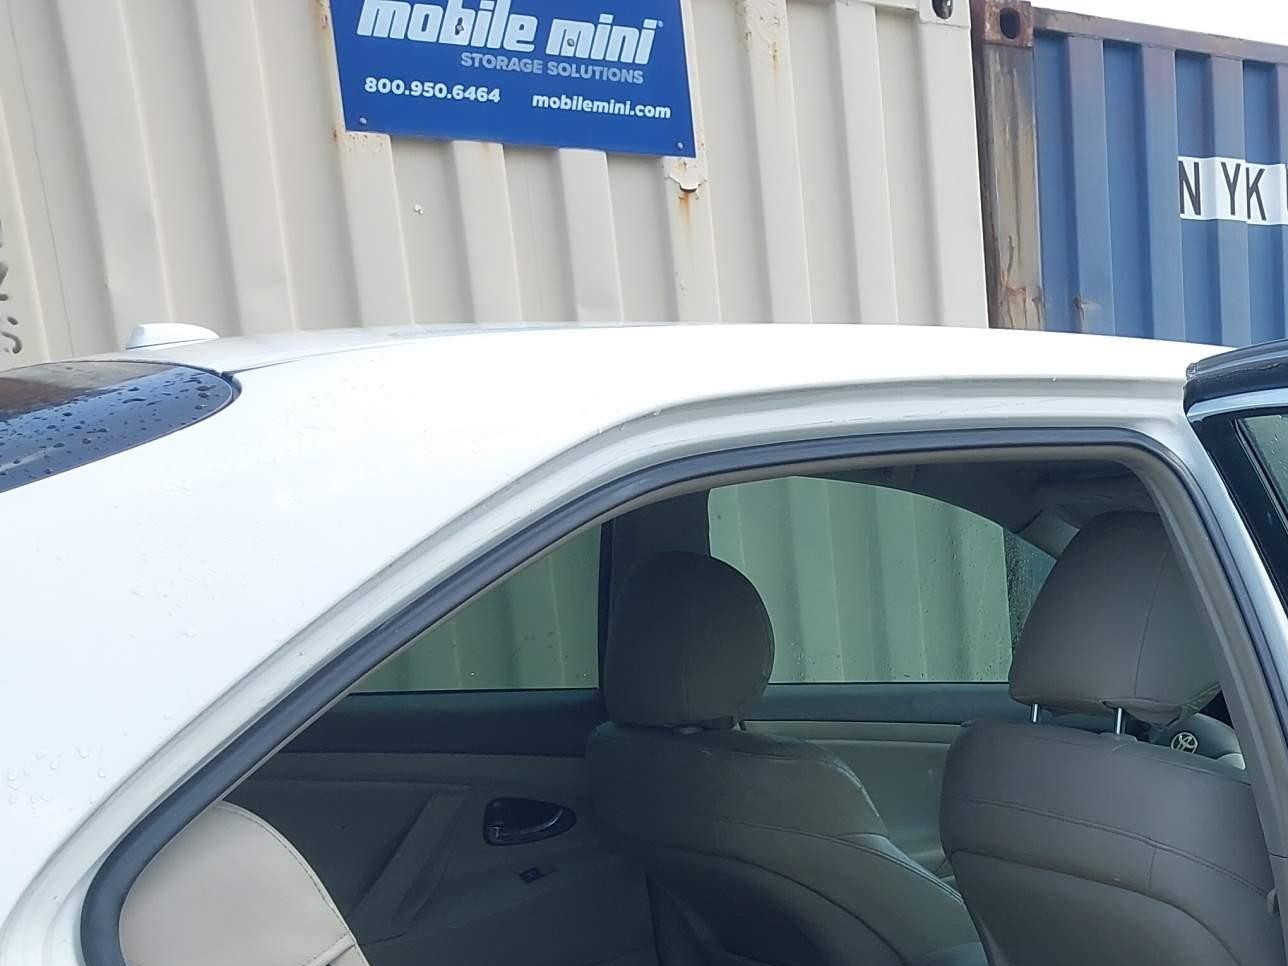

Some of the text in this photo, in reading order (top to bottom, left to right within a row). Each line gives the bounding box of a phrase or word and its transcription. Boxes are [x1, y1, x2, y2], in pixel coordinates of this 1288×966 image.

[357, 0, 658, 65] mobile mini
[461, 52, 644, 84] STORAGE SOLUTIONS
[364, 77, 501, 103] 800.950.6464
[532, 92, 671, 119] mobilemini.com
